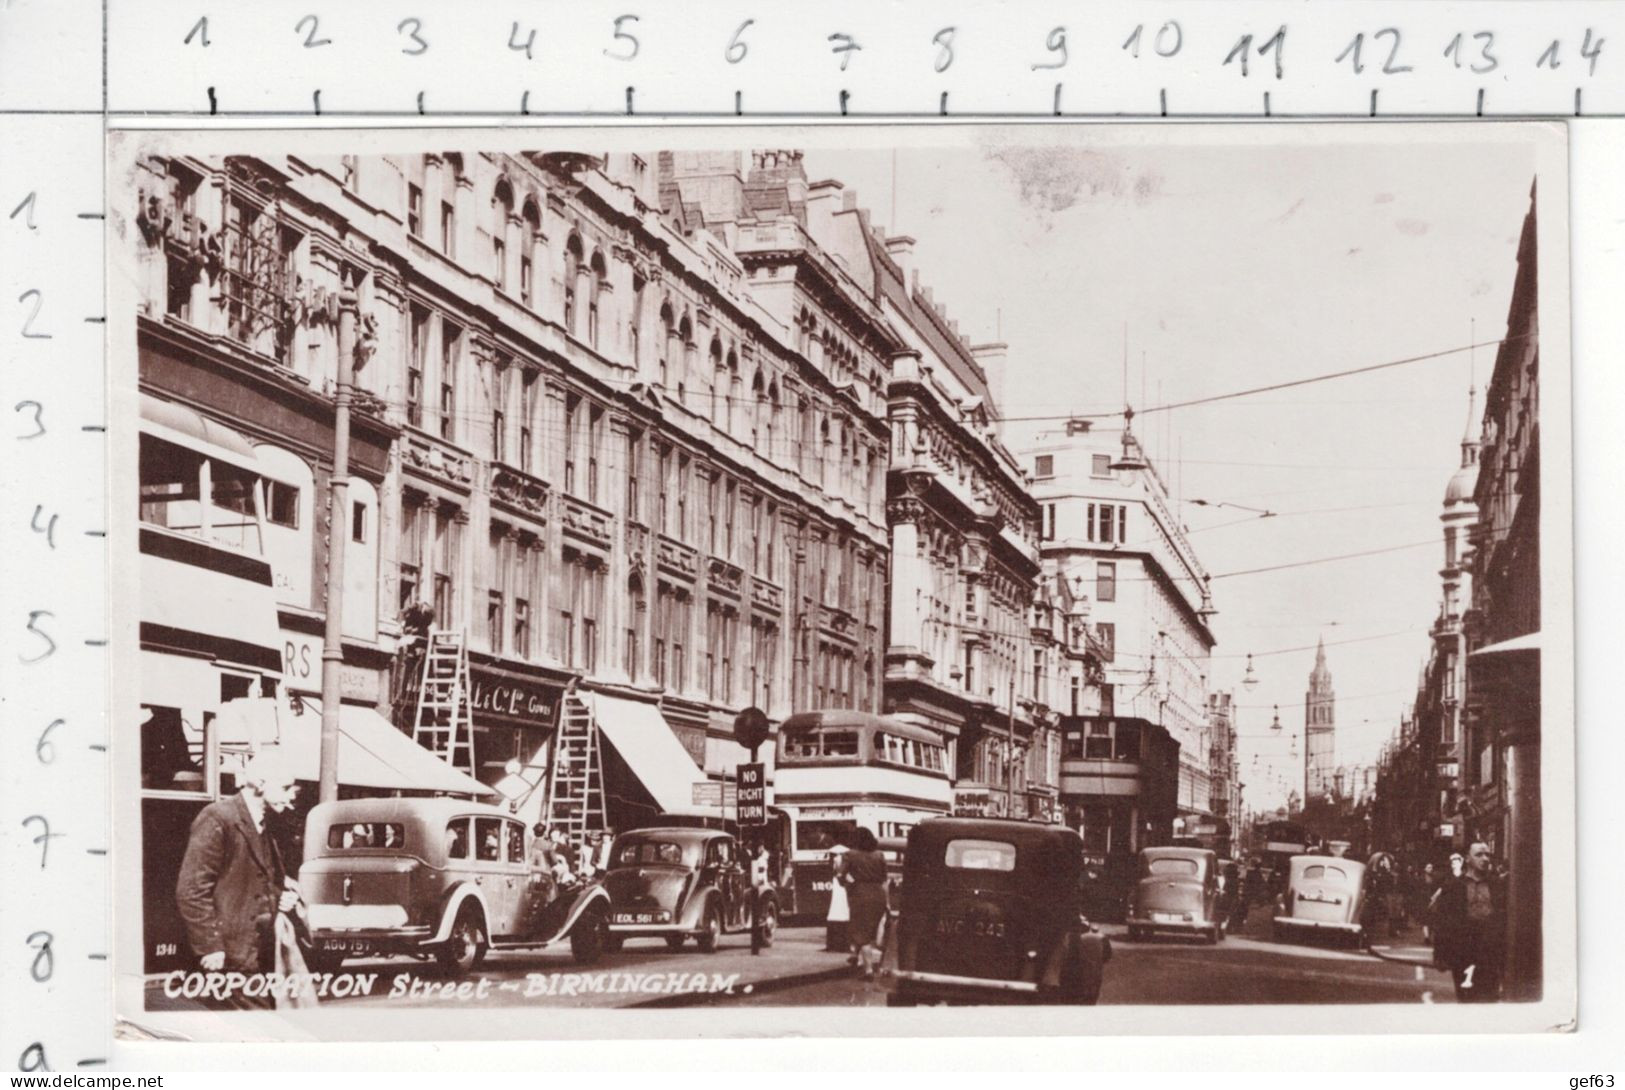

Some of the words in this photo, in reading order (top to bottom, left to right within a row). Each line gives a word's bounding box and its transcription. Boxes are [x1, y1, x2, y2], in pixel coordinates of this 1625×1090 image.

[180, 16, 211, 48] 1
[295, 15, 332, 49] 2
[397, 17, 429, 57] 3
[507, 21, 537, 61] 4
[604, 14, 640, 61] 5
[724, 19, 755, 65] 6
[826, 31, 863, 72] 7
[932, 26, 957, 73] 8
[1031, 26, 1068, 72] 9
[1121, 20, 1183, 58] 10
[1222, 25, 1287, 80] 11
[1335, 26, 1413, 75] 12
[1443, 30, 1498, 74] 13
[1536, 28, 1606, 77] 14
[9, 191, 38, 231] 1
[18, 288, 53, 340] 2
[14, 400, 47, 441] 3
[30, 503, 60, 550] 4
[19, 609, 57, 663] 5
[36, 717, 67, 765] 6
[739, 788, 763, 800] RIGHT
[743, 771, 757, 783] NO
[740, 806, 763, 819] TURN
[21, 814, 67, 869] 7
[25, 930, 54, 984] 8
